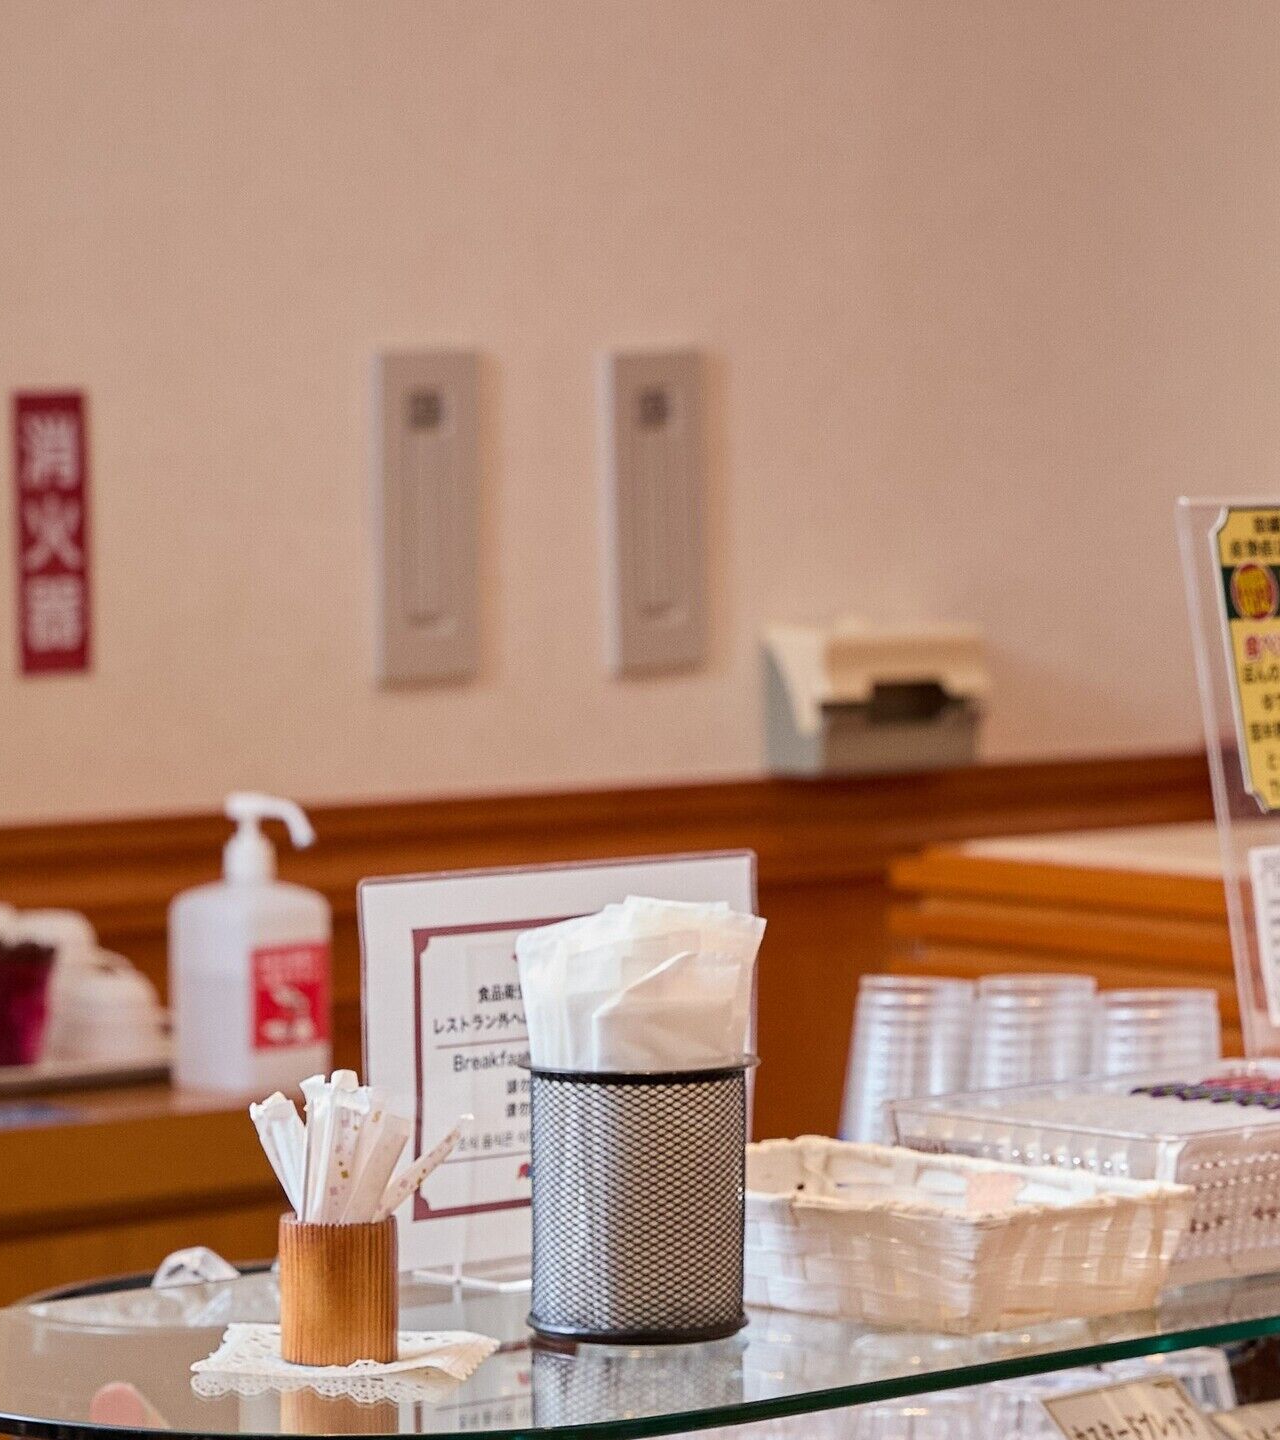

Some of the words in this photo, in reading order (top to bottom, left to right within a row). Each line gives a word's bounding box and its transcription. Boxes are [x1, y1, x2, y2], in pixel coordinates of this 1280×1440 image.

[478, 983, 523, 1003] 食品衛
[433, 1010, 527, 1035] レストラン外へ
